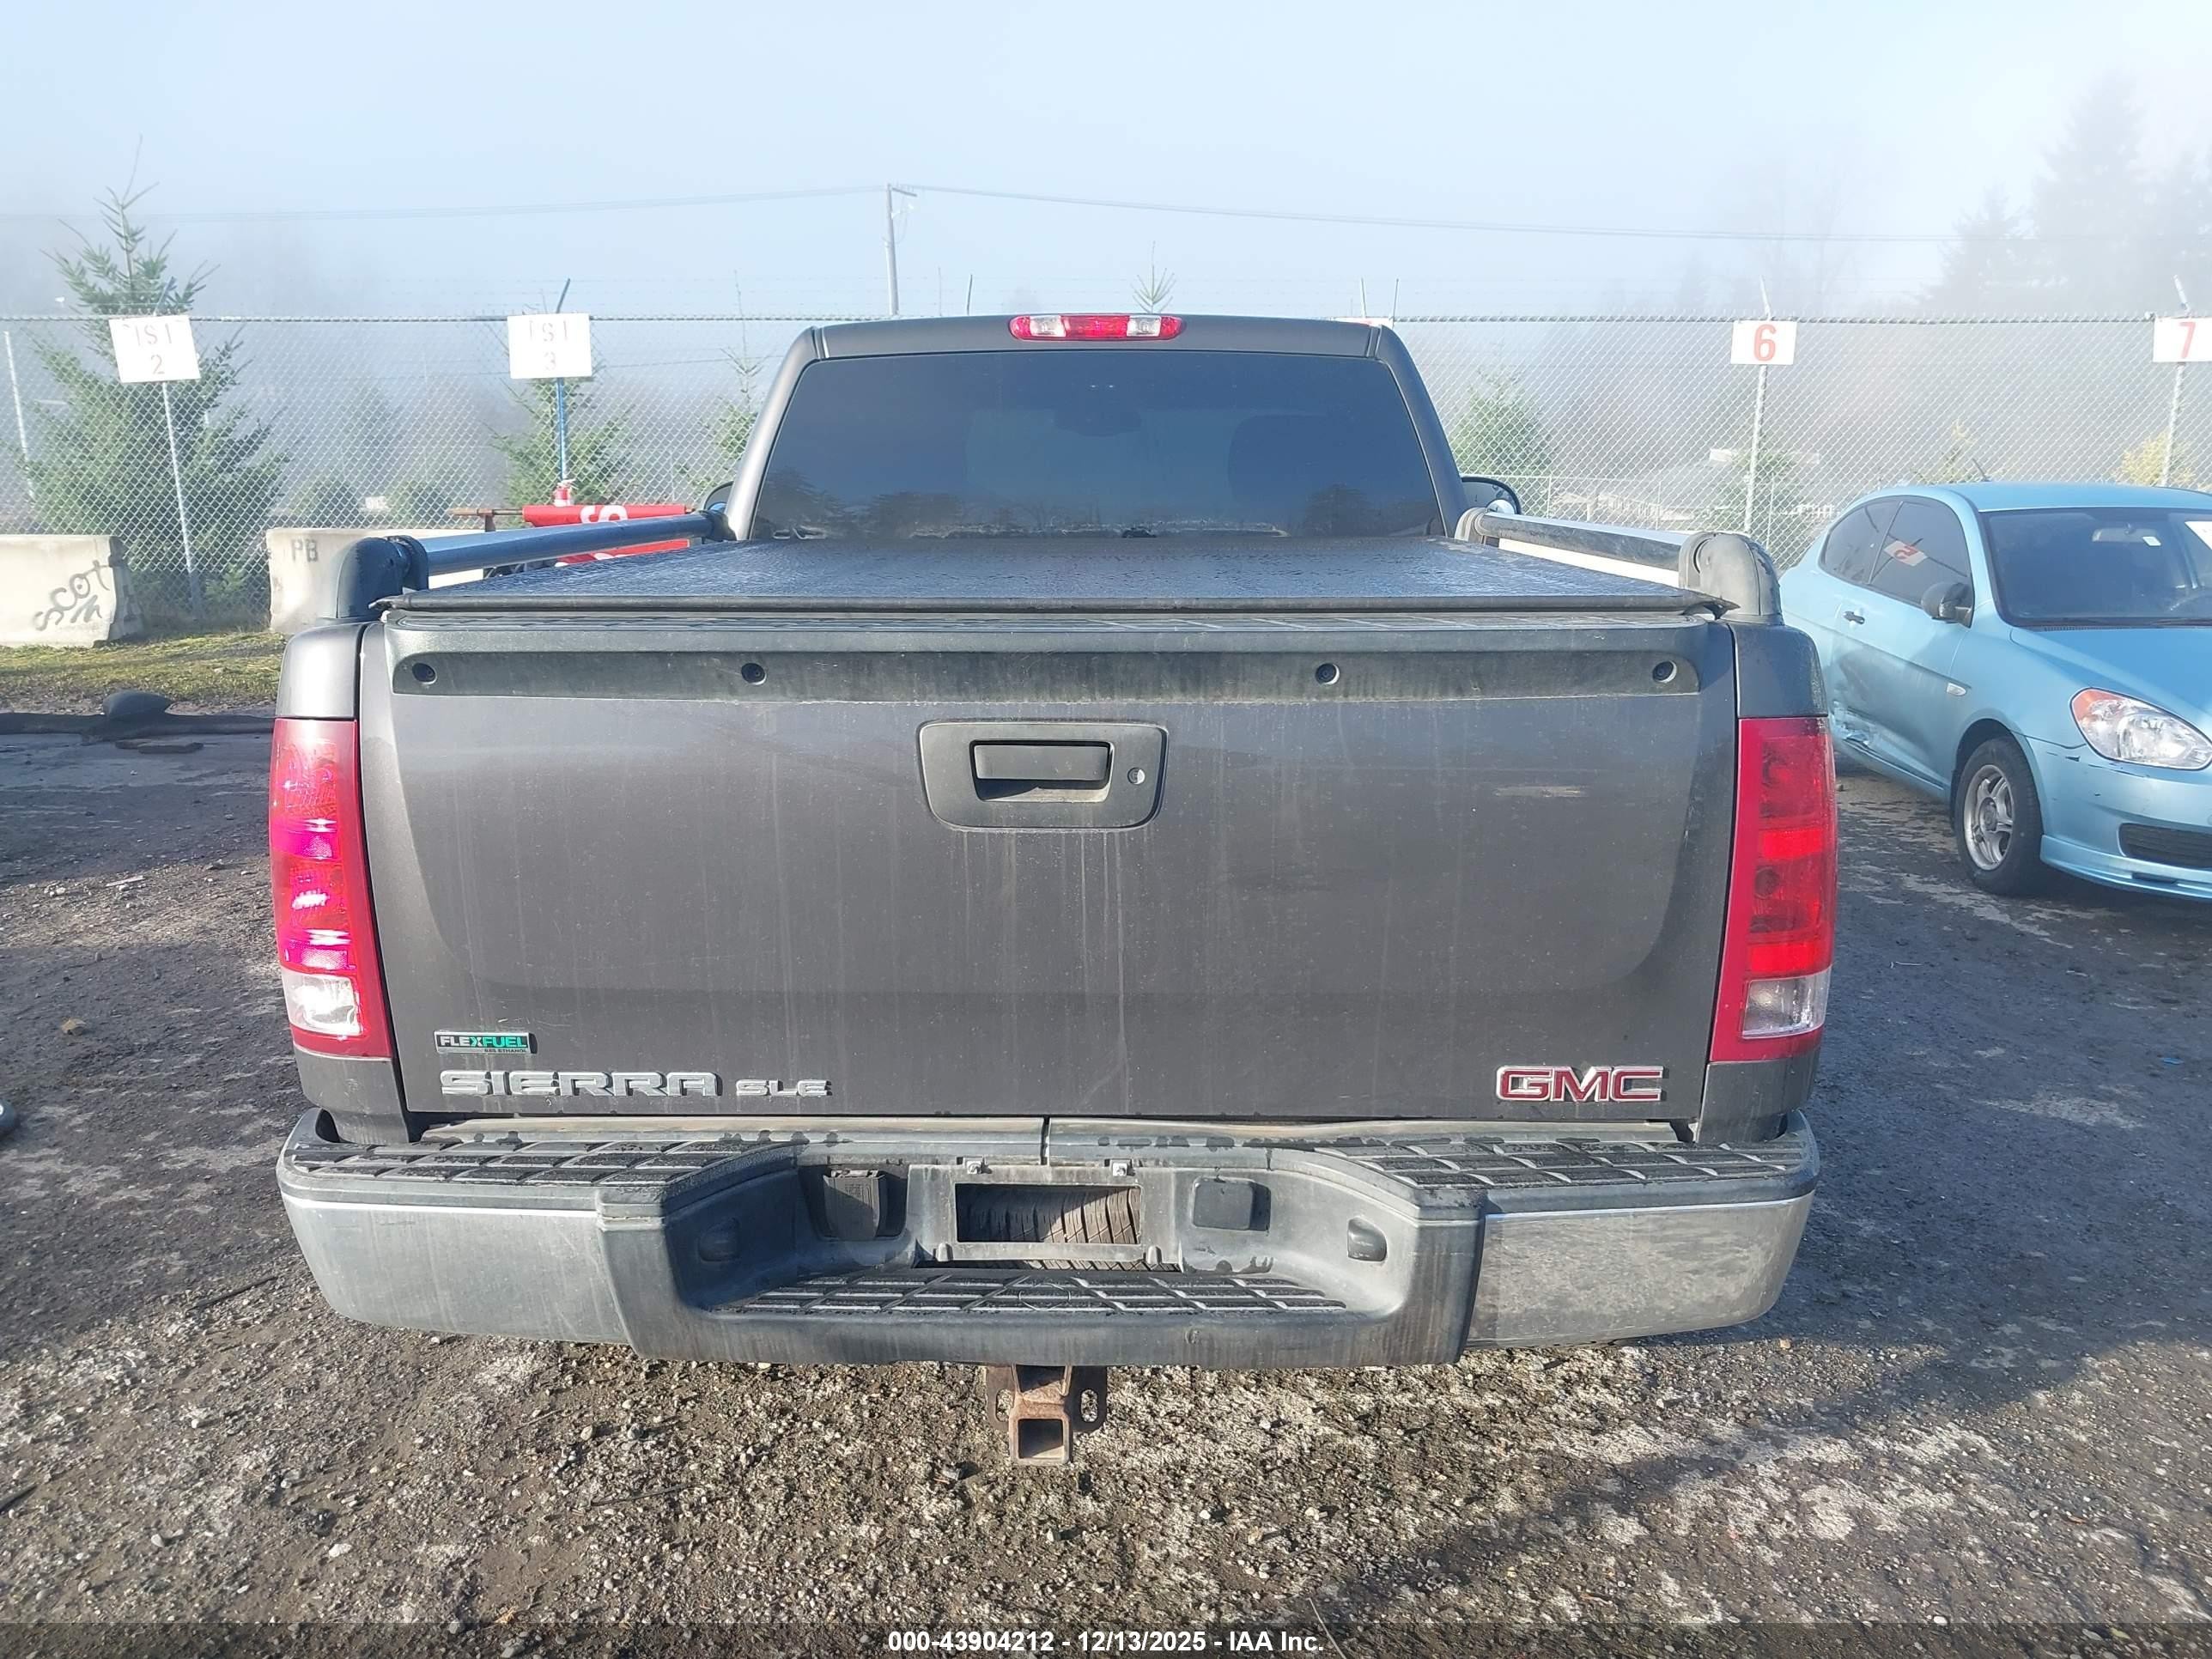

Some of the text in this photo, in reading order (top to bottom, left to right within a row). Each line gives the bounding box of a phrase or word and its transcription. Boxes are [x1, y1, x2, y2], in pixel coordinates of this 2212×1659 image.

[1753, 324, 1777, 362] 6
[2179, 322, 2197, 359] 7
[151, 354, 165, 374] 2
[291, 538, 318, 562] PB
[440, 1070, 830, 1097] SIERRA SLE
[1497, 1066, 1664, 1102] GMC
